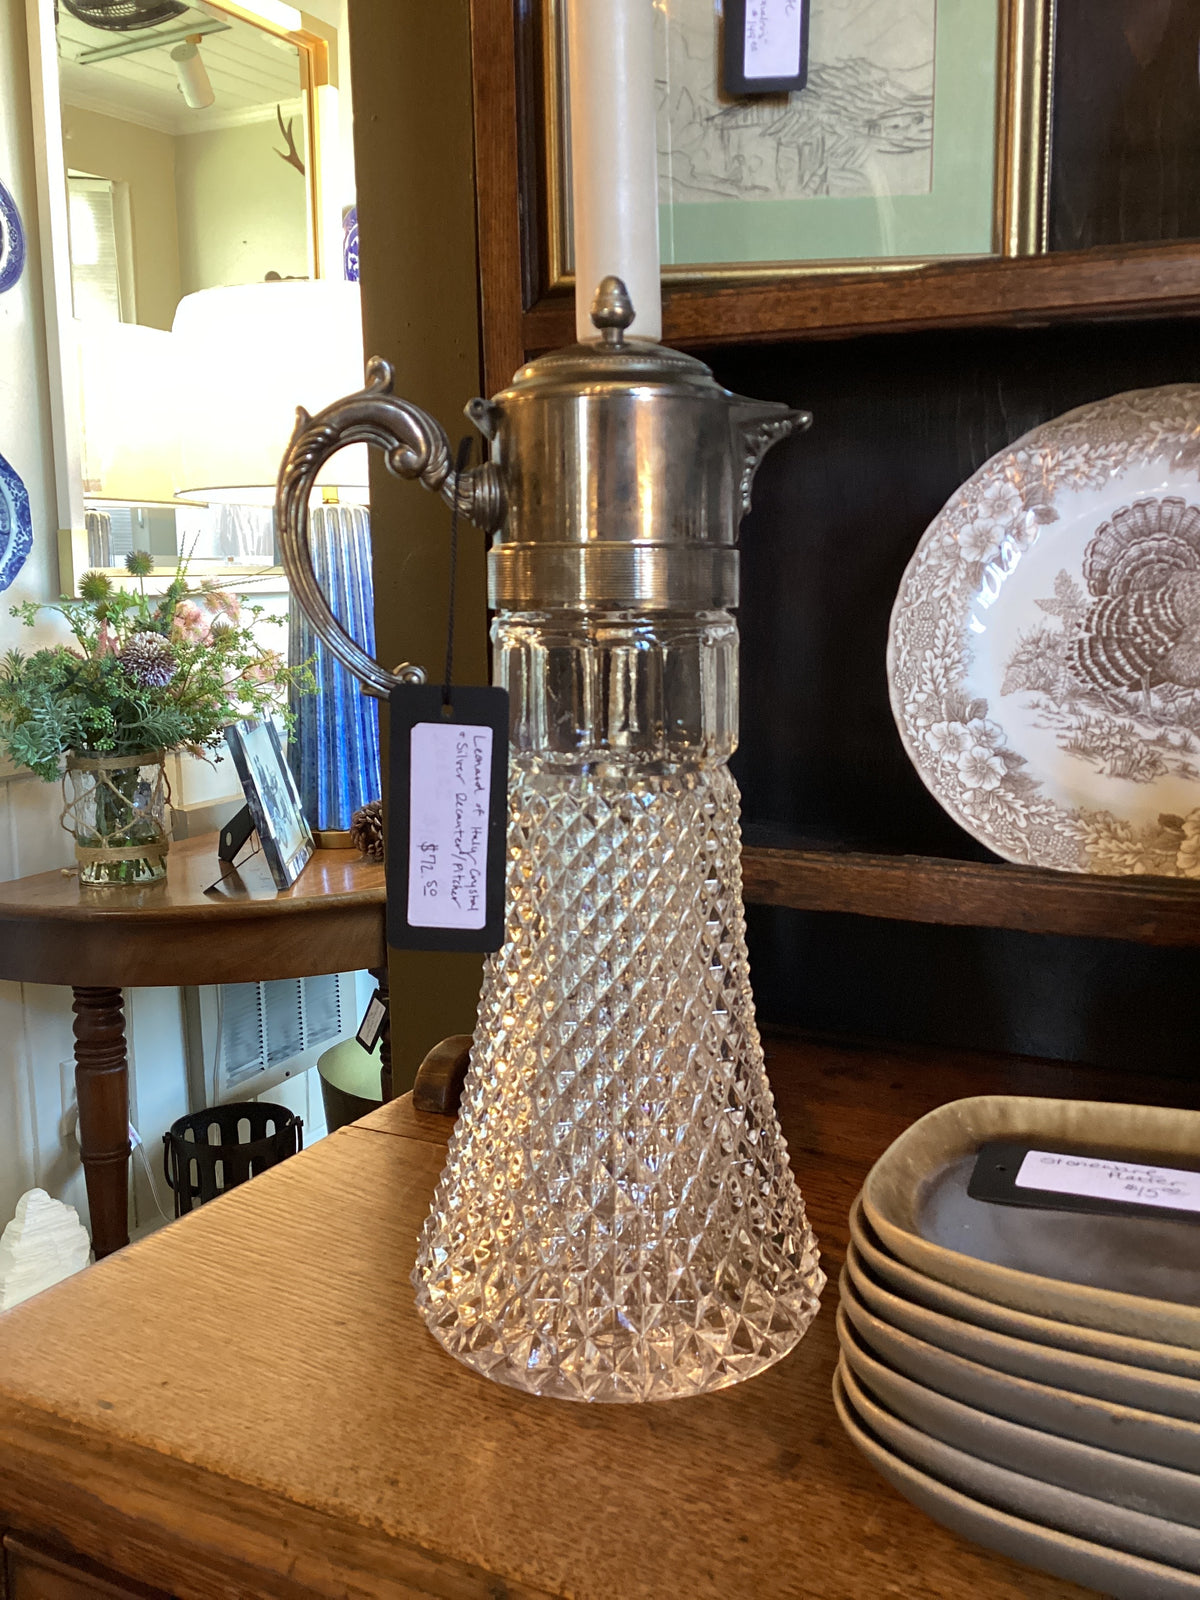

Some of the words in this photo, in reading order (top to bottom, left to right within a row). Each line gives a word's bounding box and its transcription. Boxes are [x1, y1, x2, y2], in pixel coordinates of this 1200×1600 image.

[455, 742, 468, 785] Silver
[473, 735, 486, 794] Leonard
[476, 803, 486, 817] of
[459, 826, 482, 864] Italy
[466, 868, 481, 912] Crystal
